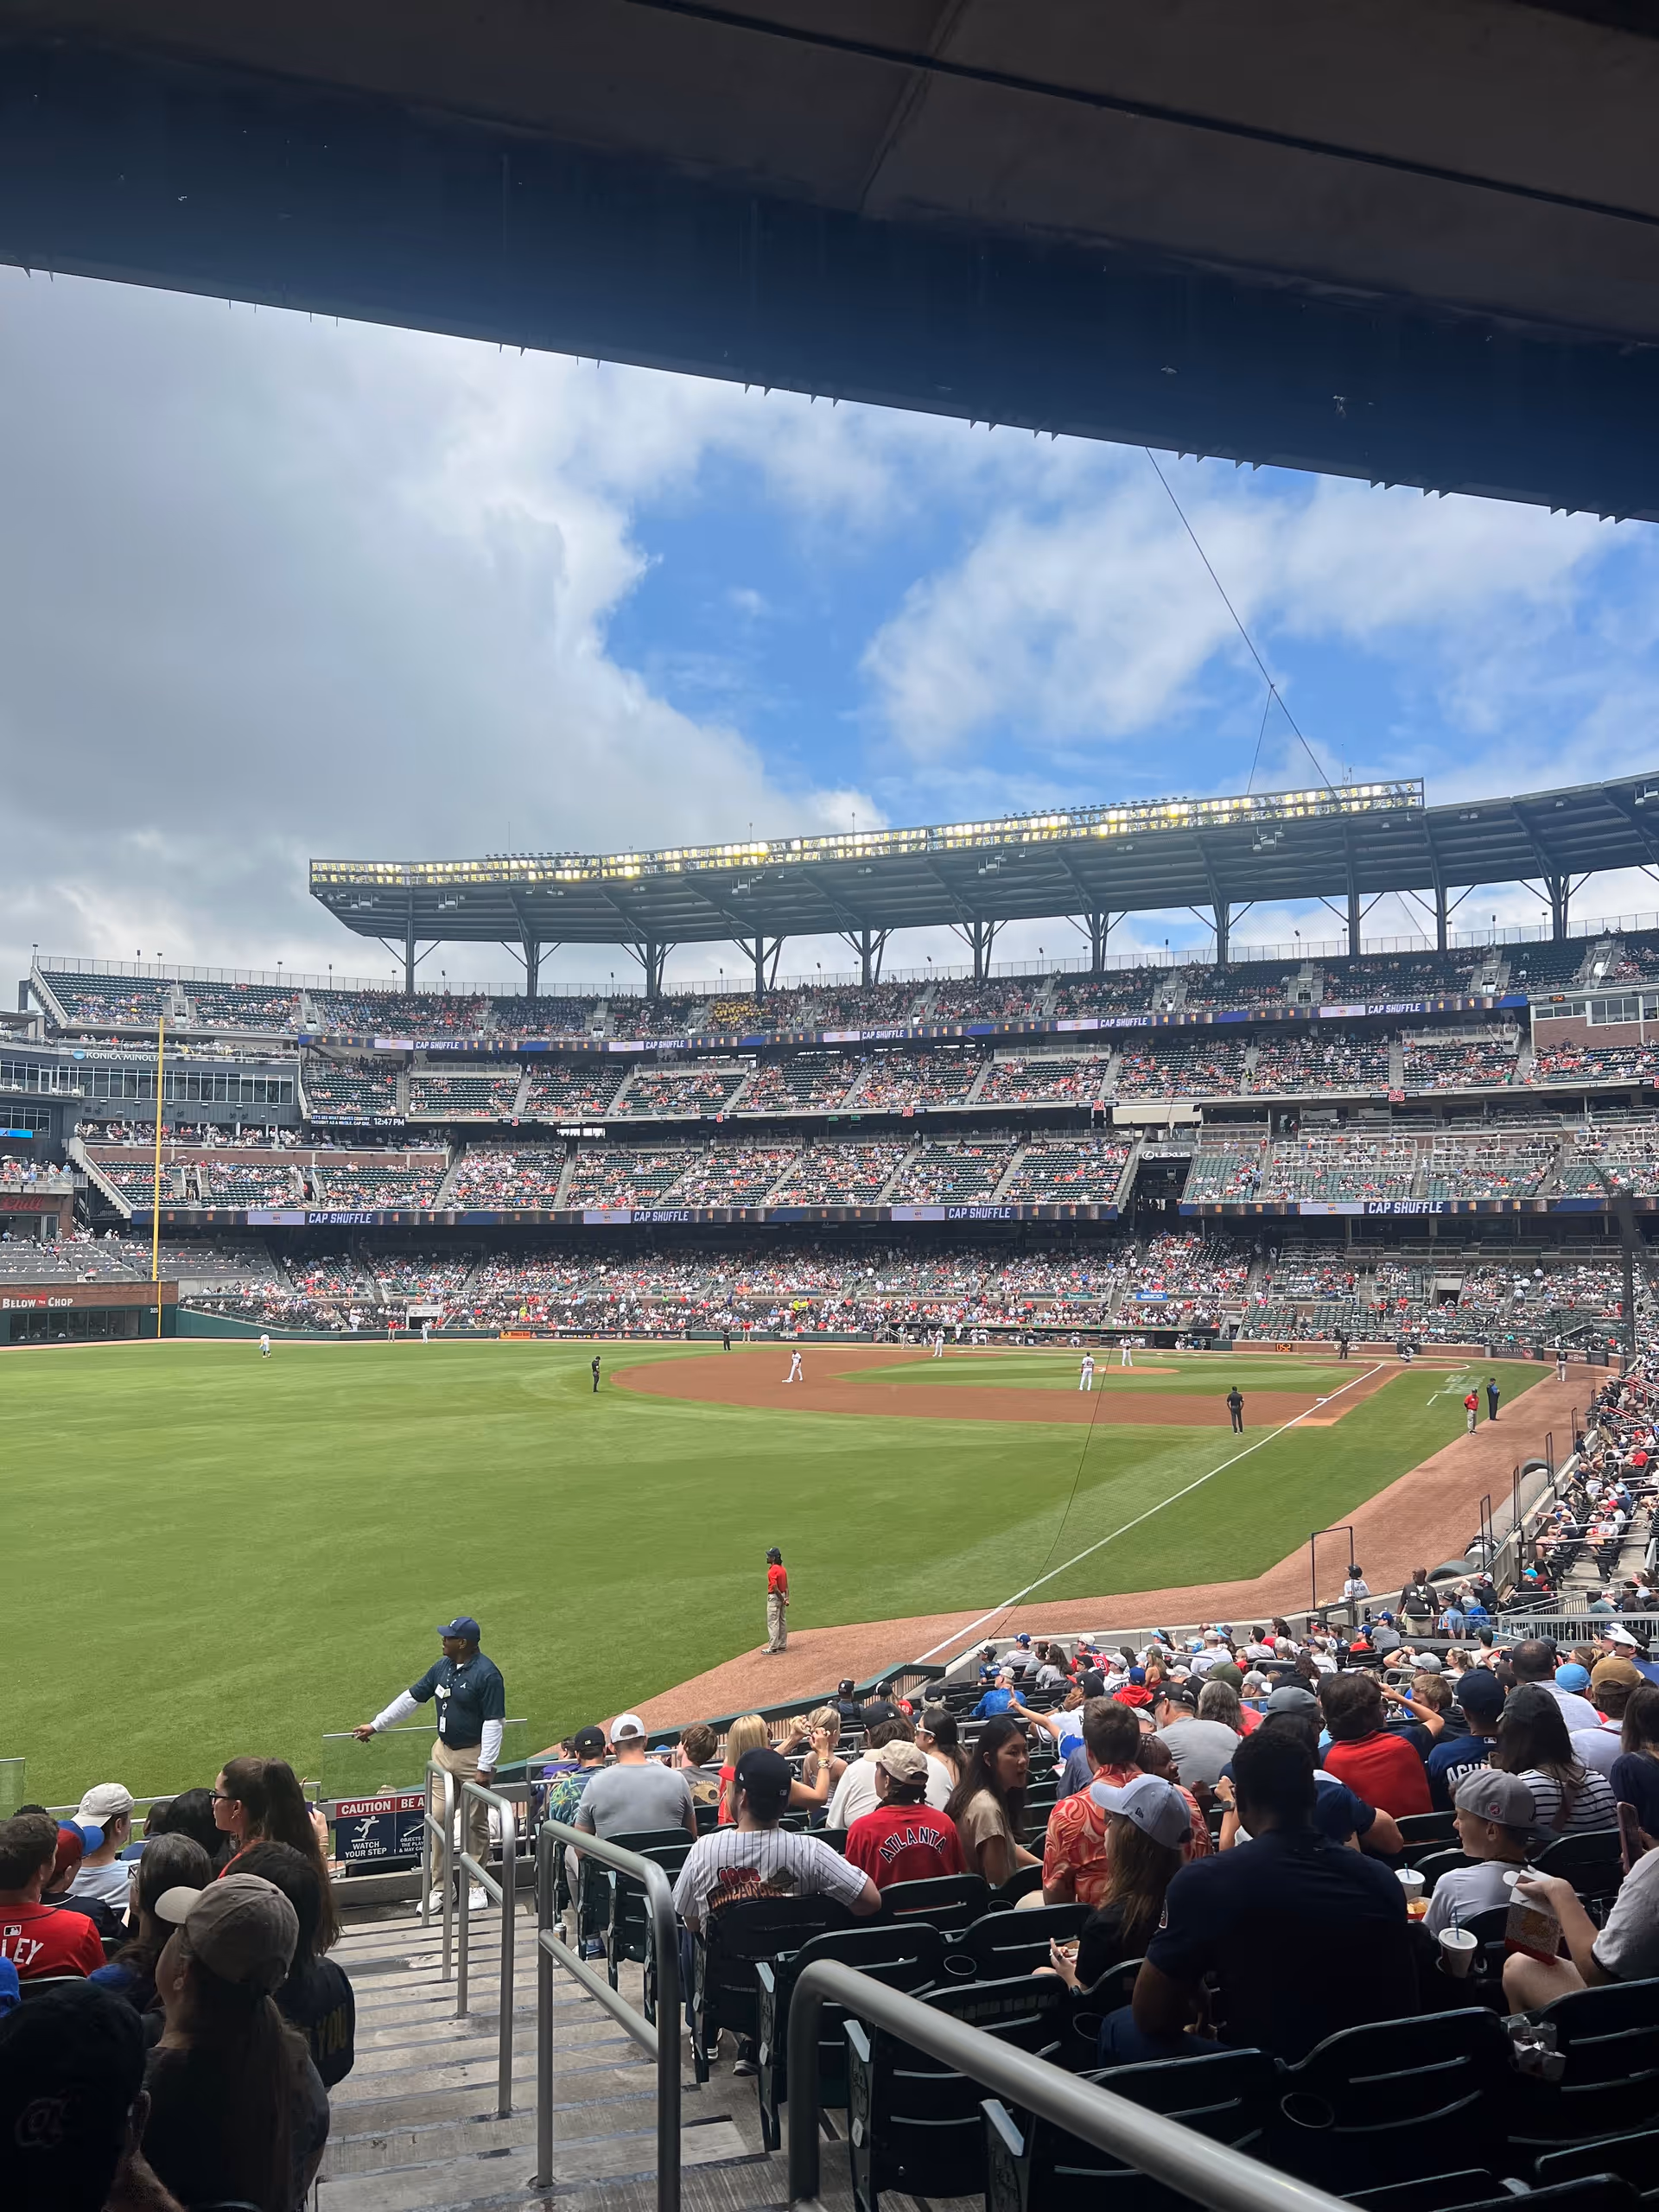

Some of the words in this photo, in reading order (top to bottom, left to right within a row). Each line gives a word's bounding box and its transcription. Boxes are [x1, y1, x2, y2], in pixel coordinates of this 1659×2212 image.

[1368, 1005, 1384, 1014] CAP
[1385, 1003, 1421, 1013] SHUFFLE
[1100, 1019, 1116, 1027] CAP
[1116, 1017, 1148, 1027] SHUFFLE
[861, 1031, 875, 1039] CAP
[876, 1030, 905, 1039] SHUFFLE
[645, 1040, 658, 1049] CAP
[658, 1039, 684, 1048] SHUFFLE
[1389, 1090, 1405, 1102] 25
[1093, 1099, 1105, 1110] 21
[902, 1106, 914, 1116] 10
[373, 1117, 391, 1126] 12:47
[512, 1116, 518, 1127] 3
[949, 1208, 968, 1218] CAP
[969, 1207, 1011, 1218] SHUFFLE
[1368, 1202, 1388, 1214] CAP
[1394, 1202, 1443, 1213] SHUFFLE
[308, 1213, 328, 1224] CAP
[330, 1213, 372, 1224] SHUFFLE
[634, 1211, 651, 1222] CAP
[652, 1211, 690, 1222] SHUFFLE
[2, 1298, 36, 1309] BELOW
[48, 1297, 73, 1307] CHOP
[1096, 1658, 1105, 1669] 3
[341, 1801, 391, 1815] CAUTION
[401, 1798, 415, 1808] BE
[353, 1840, 380, 1851] WATCH
[879, 1826, 947, 1864] ATLANTA
[345, 1849, 366, 1859] YOUR
[367, 1847, 387, 1856] STEP
